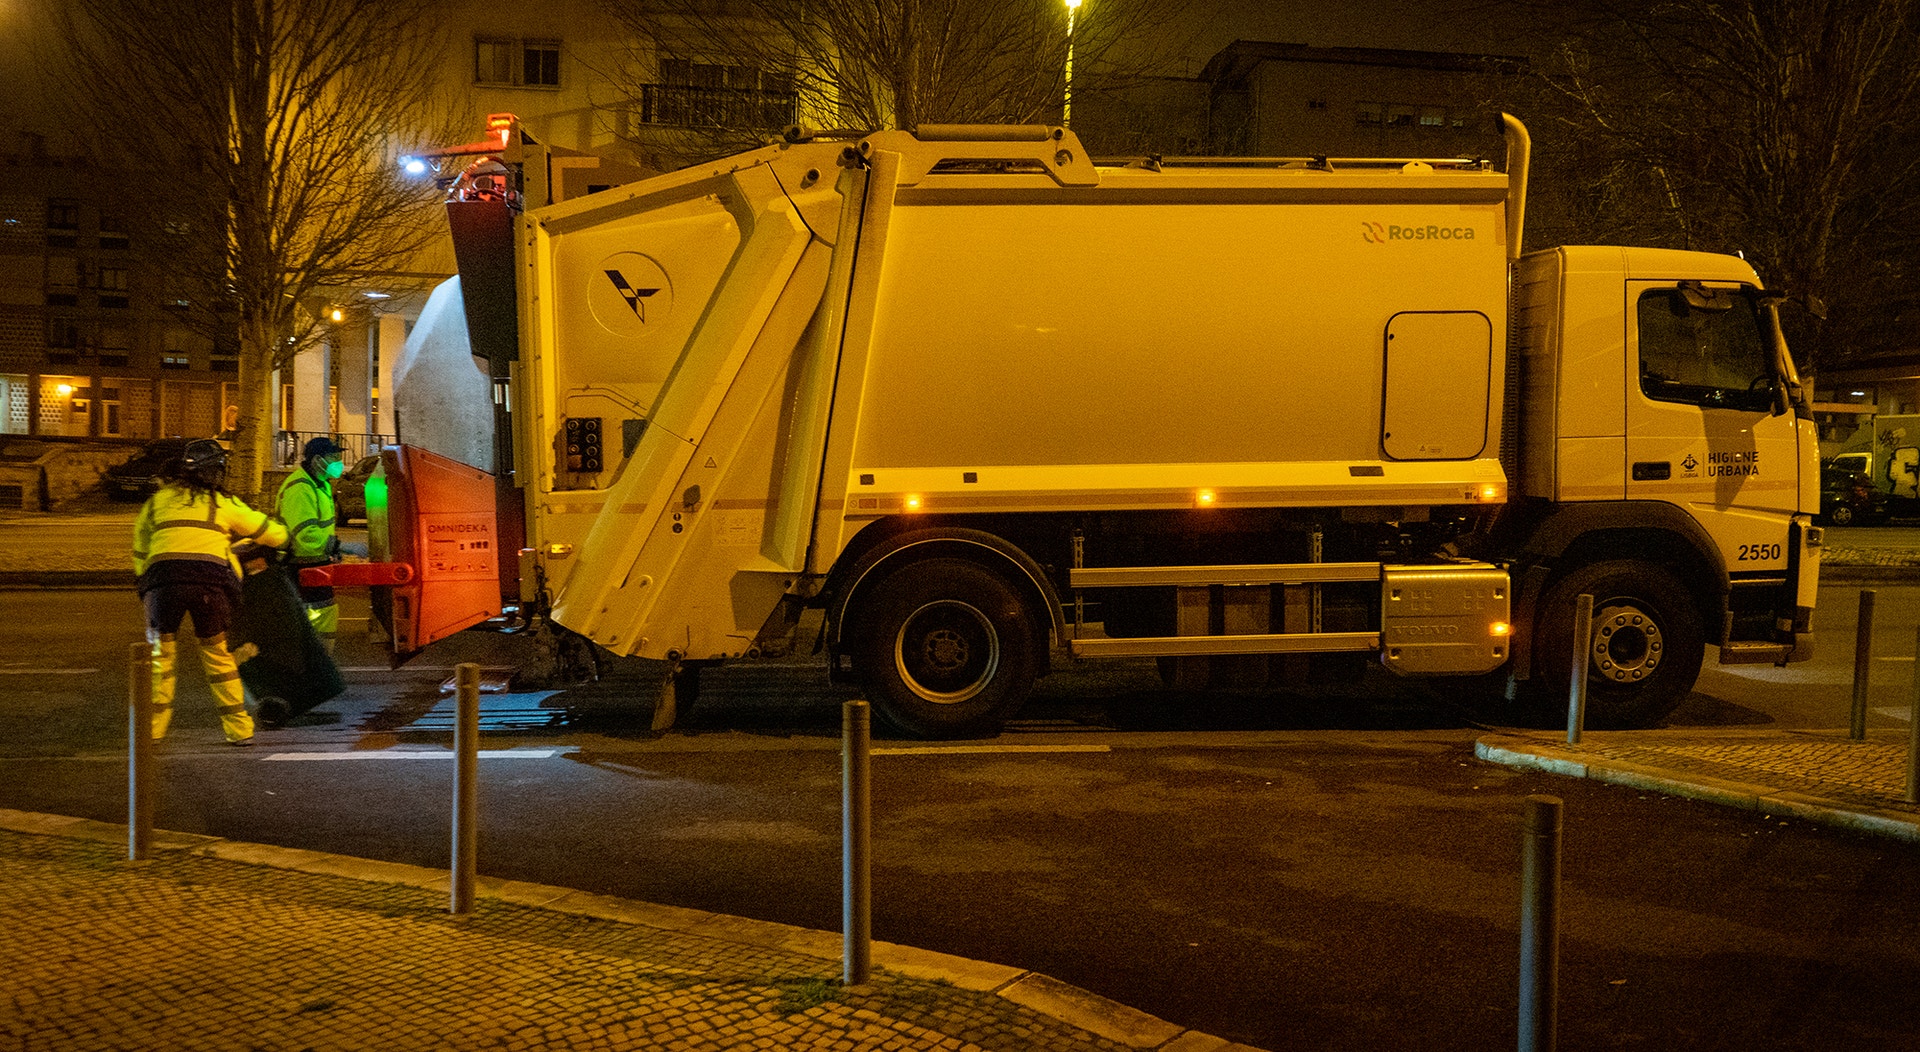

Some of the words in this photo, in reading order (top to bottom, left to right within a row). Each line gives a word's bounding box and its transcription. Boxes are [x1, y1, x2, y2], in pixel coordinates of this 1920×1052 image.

[1388, 225, 1475, 240] RosRoca
[1708, 451, 1760, 463] HIGIENE
[1708, 465, 1760, 477] URBANA
[427, 524, 489, 534] OMNIDEKA
[1737, 543, 1781, 561] 2550
